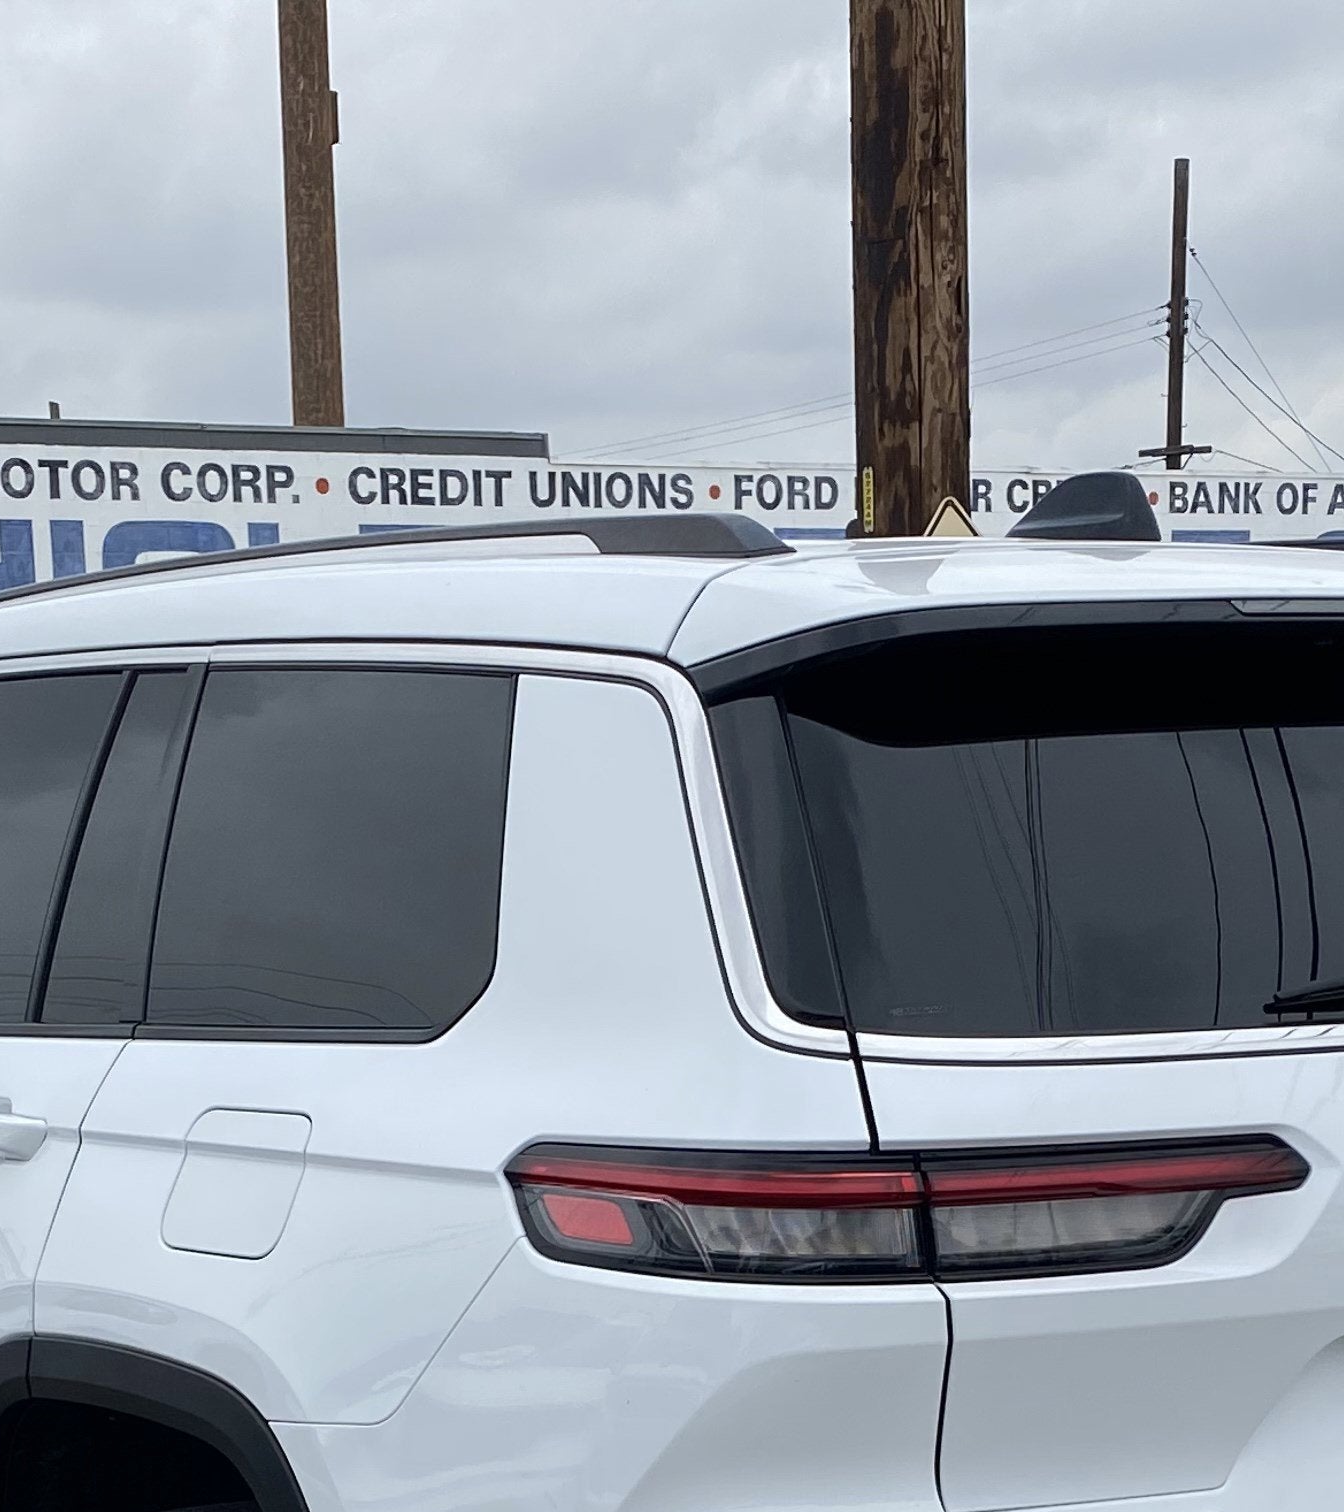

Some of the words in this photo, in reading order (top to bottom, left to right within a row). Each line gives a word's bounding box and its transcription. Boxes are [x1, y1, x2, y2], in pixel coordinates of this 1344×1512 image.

[160, 461, 301, 505] CORP.
[348, 465, 512, 507] CREDIT
[529, 470, 695, 511] UNIONS
[733, 473, 839, 512] FORD
[1168, 480, 1264, 515] BANK
[1276, 482, 1319, 516] OF
